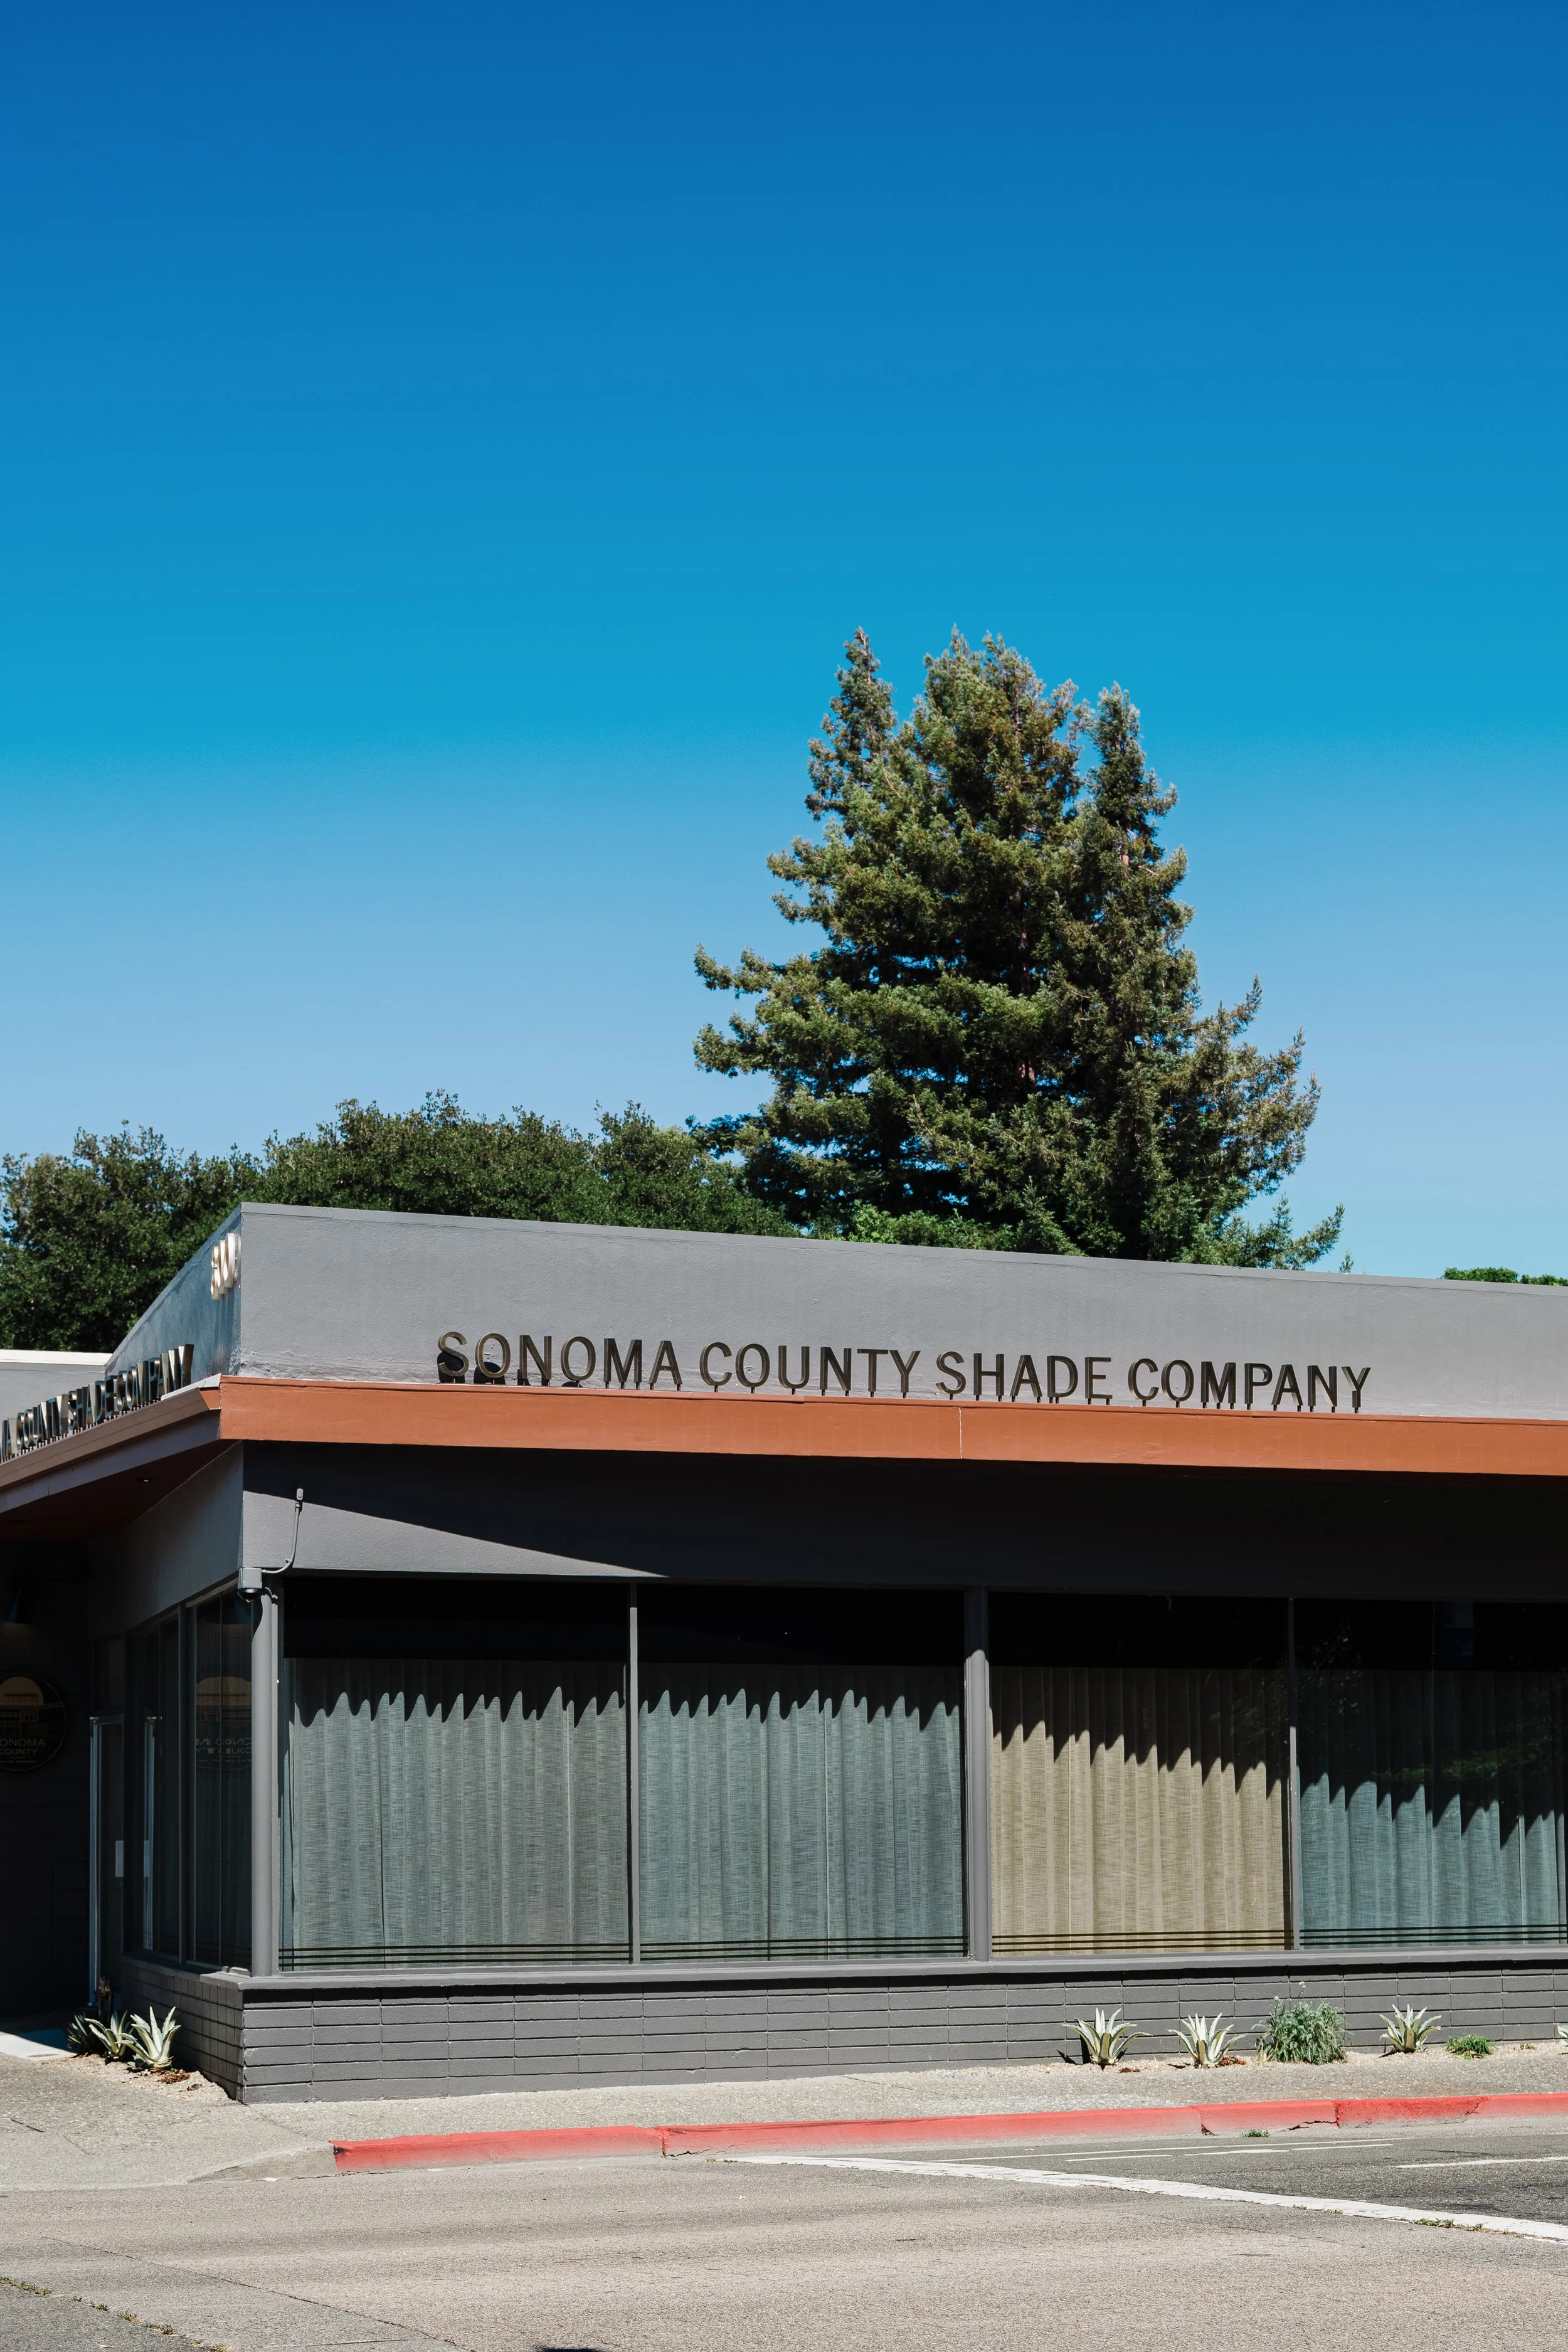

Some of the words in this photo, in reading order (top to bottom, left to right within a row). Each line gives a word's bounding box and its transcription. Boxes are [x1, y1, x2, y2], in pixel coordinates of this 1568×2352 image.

[437, 1332, 683, 1386] SONOMA
[699, 1342, 921, 1394] COUNTY
[936, 1351, 1113, 1399] SHADE
[1128, 1359, 1371, 1409] COMPANY
